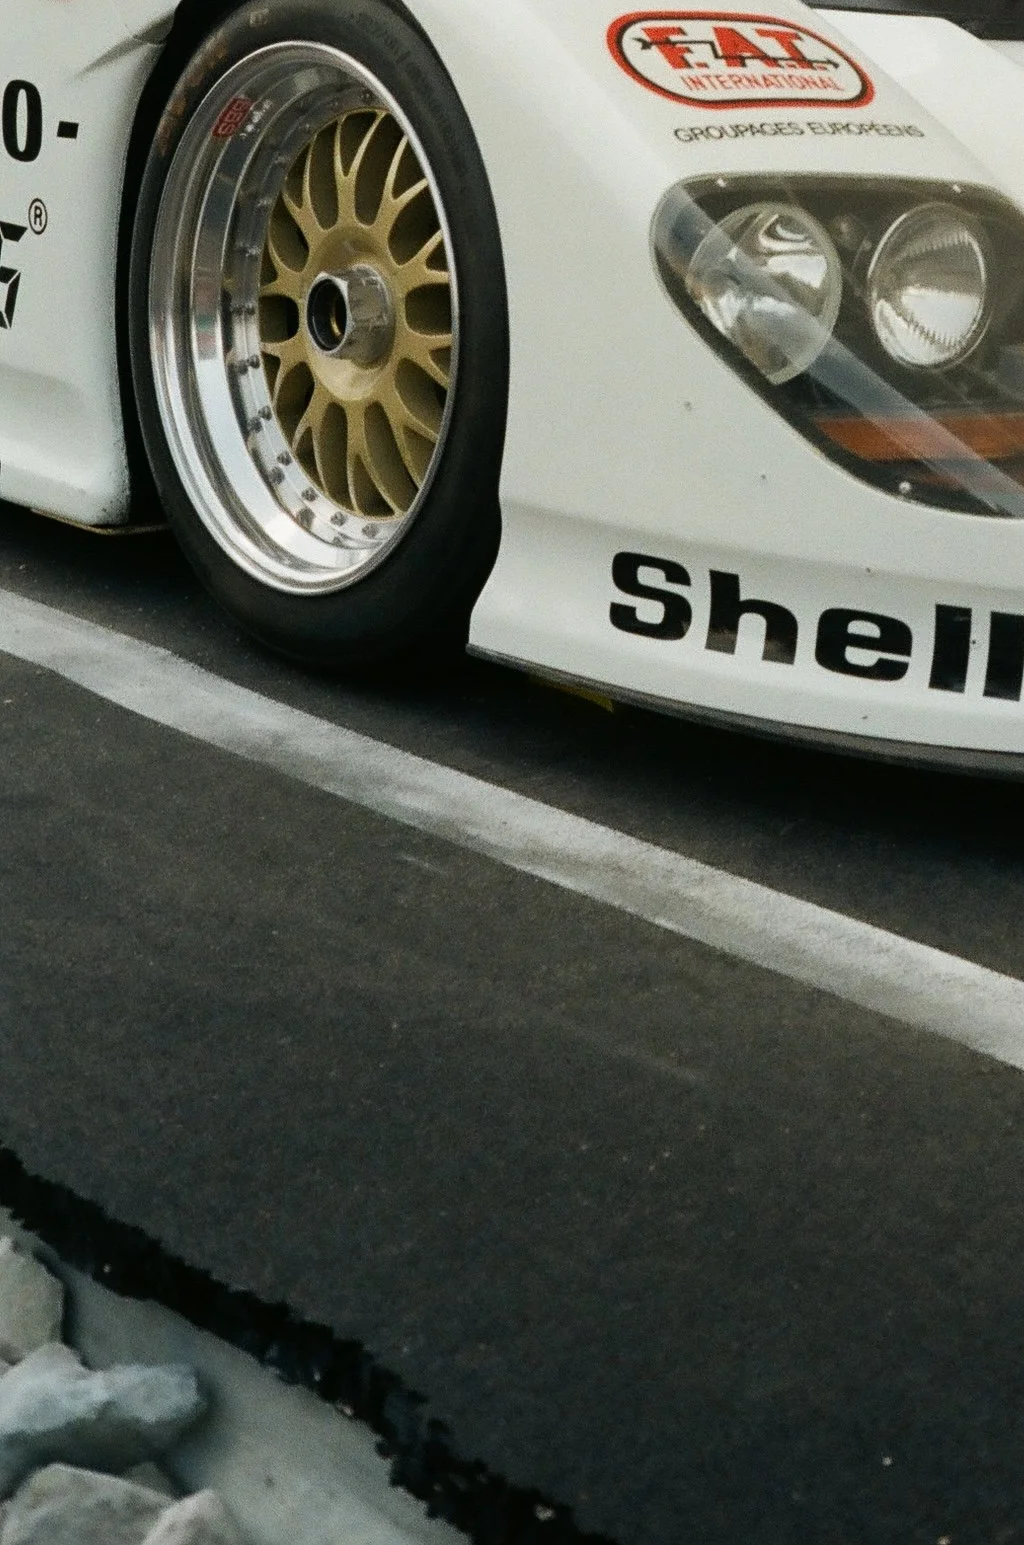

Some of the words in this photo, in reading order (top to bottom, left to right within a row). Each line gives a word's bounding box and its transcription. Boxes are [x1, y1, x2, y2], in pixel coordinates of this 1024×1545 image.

[680, 72, 847, 93] INTERNATIONAL
[674, 121, 805, 143] GROUPAGES
[807, 119, 925, 138] EUROPÉENS
